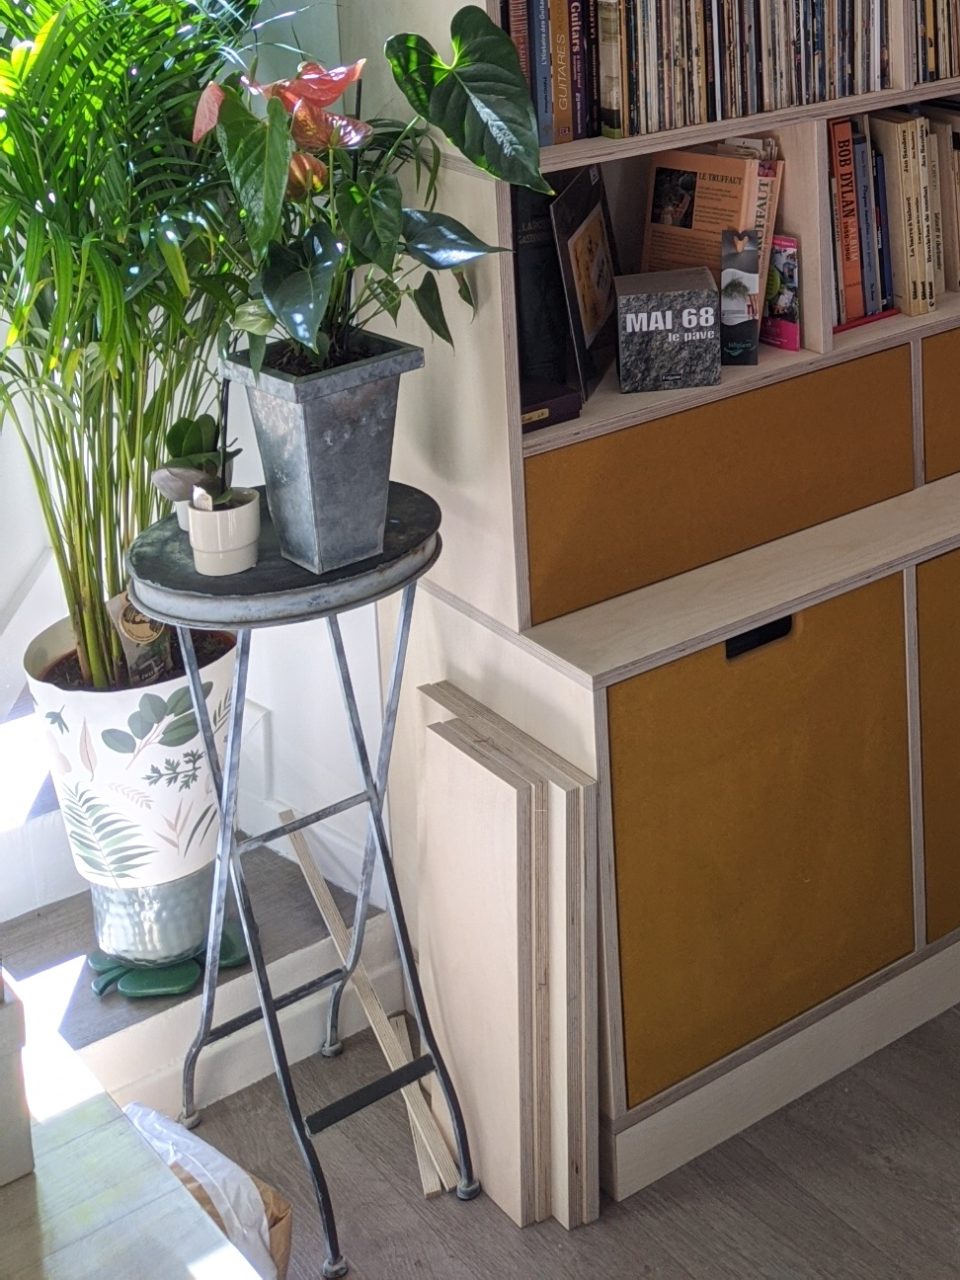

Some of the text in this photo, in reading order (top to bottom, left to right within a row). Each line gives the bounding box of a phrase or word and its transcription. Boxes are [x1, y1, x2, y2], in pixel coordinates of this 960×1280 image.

[569, 1, 582, 53] Guitars
[556, 33, 568, 110] GUITARES
[836, 138, 852, 168] BOB
[707, 172, 744, 186] TRUFFAUT
[840, 172, 856, 219] DYLAN
[625, 306, 715, 333] MAI 68
[667, 332, 680, 342] le
